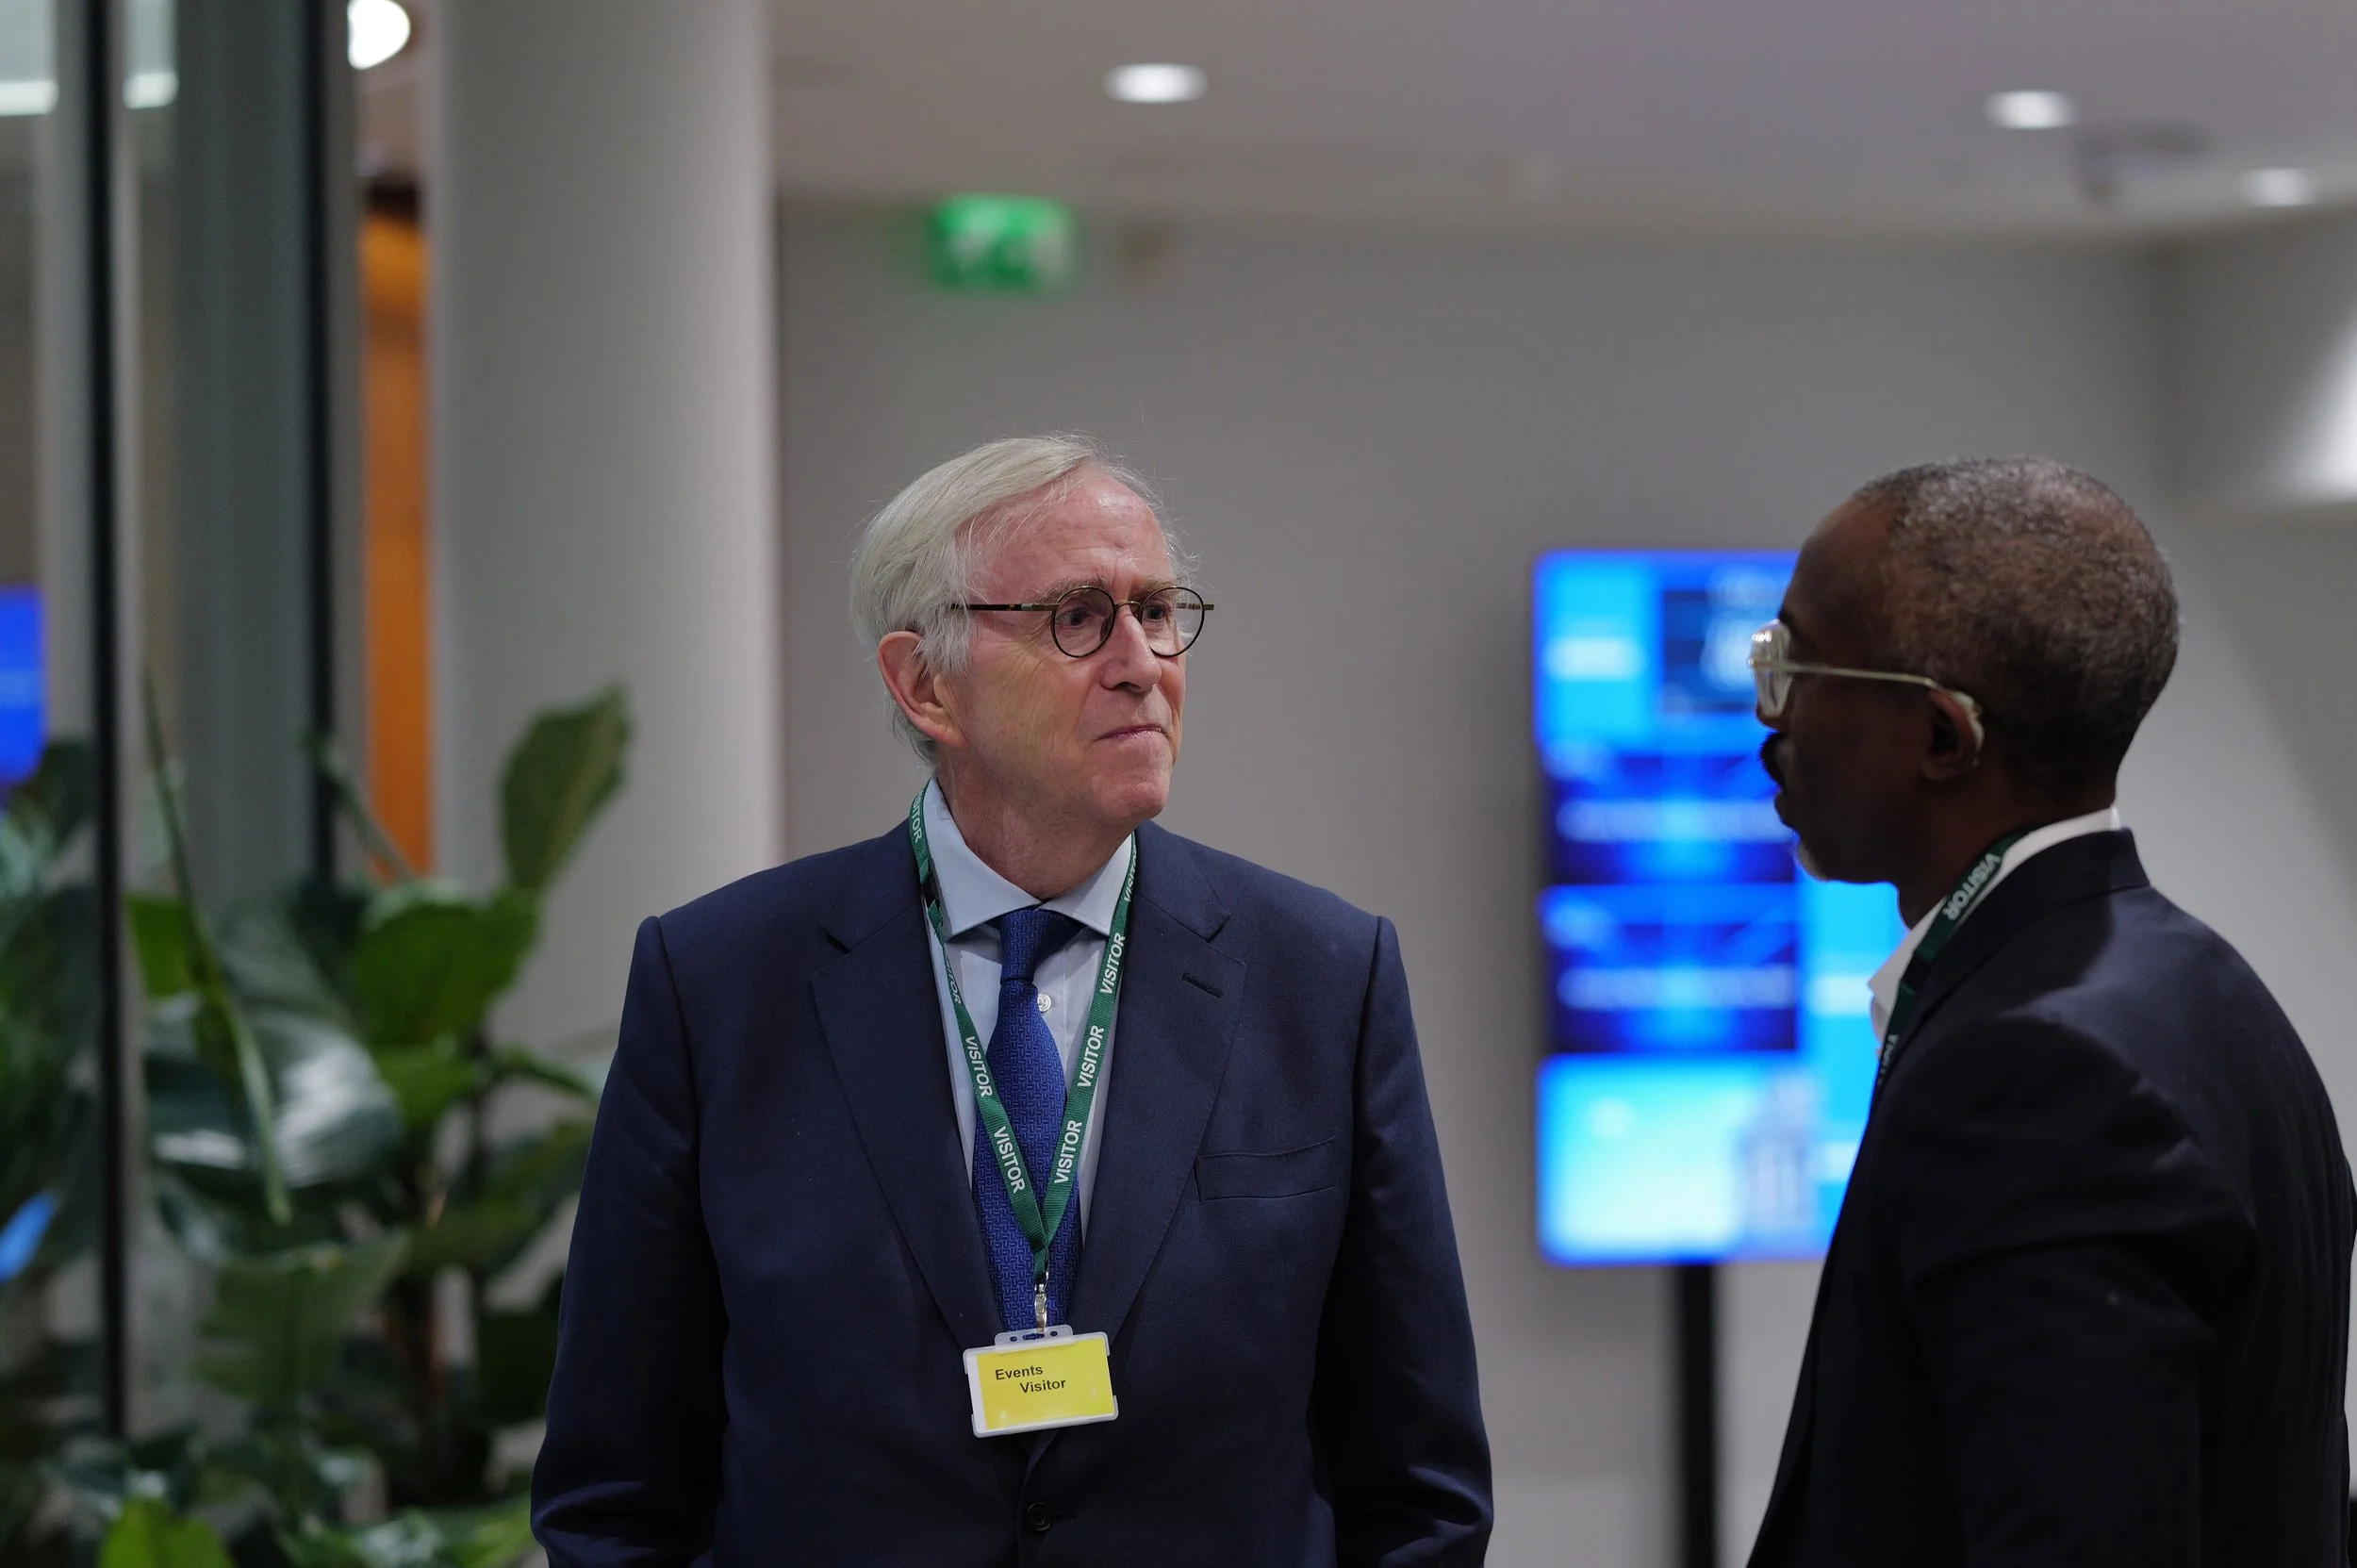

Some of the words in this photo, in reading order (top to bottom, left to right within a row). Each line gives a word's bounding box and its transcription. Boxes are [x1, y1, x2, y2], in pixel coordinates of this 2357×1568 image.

[1943, 853, 2001, 920] VISITOR
[1099, 933, 1126, 995] VISITOR
[965, 1036, 993, 1097] VISITOR
[1078, 1025, 1104, 1087] VISITOR
[994, 1126, 1025, 1194] VISITOR
[1054, 1120, 1082, 1183] VISITOR
[995, 1365, 1044, 1380] Events
[1019, 1379, 1066, 1394] Visitor
